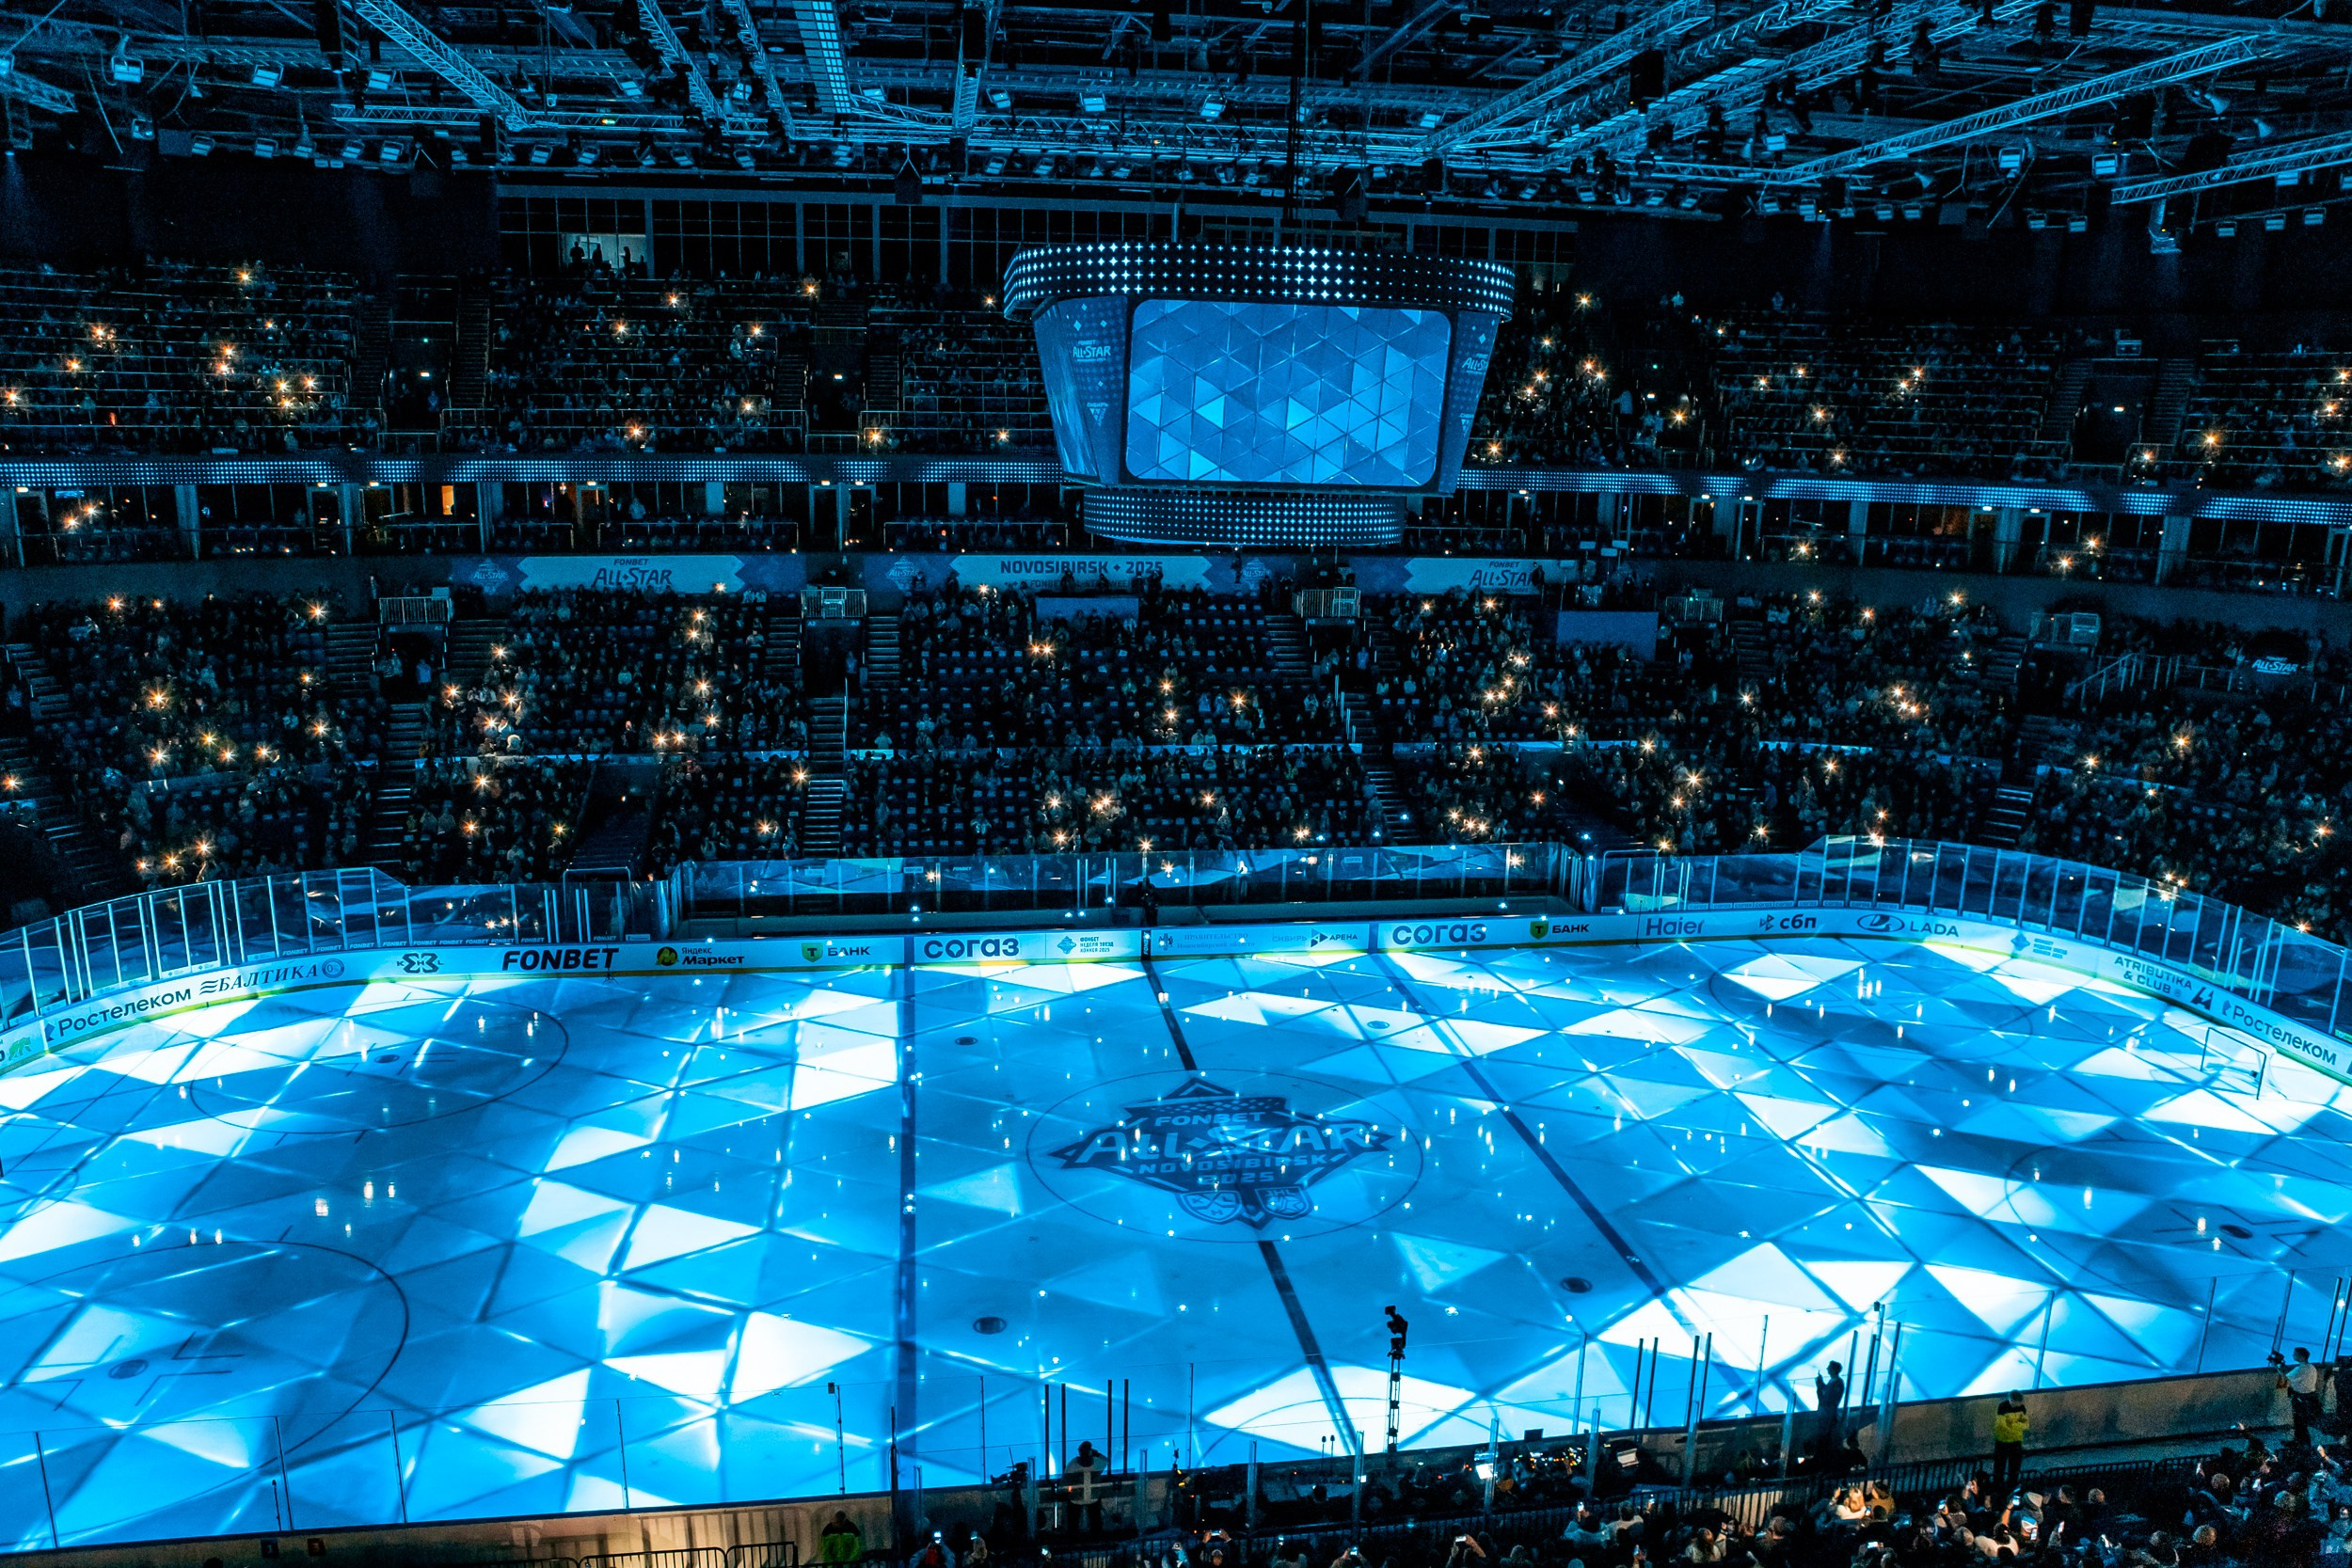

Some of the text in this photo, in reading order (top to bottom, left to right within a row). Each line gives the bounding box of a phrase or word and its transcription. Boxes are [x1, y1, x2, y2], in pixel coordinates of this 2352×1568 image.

[613, 558, 649, 566] FONBET
[1000, 560, 1108, 574] NOVOSIBIRSK
[1551, 924, 1590, 933] БАНК
[1646, 916, 1705, 936] Haier
[1779, 913, 1817, 929] сбп
[1910, 920, 1960, 938] LADA
[1392, 923, 1487, 944] согаз
[681, 945, 712, 955] Яндекс
[827, 945, 871, 957] БАНК
[923, 938, 1019, 959] согаз
[502, 948, 619, 972] FONBET
[681, 955, 745, 966] Маркет
[218, 963, 317, 992] БАЛТИКА
[2114, 956, 2193, 990] ATRIBUTIKA
[2123, 970, 2171, 994] & CLUB
[58, 989, 192, 1037] Ростелеком
[2233, 1005, 2337, 1066] Ростелеком
[1154, 1111, 1267, 1127] FONBET
[1138, 1153, 1327, 1176] NOVOSIBIRSK
[1200, 1172, 1276, 1186] 2025
